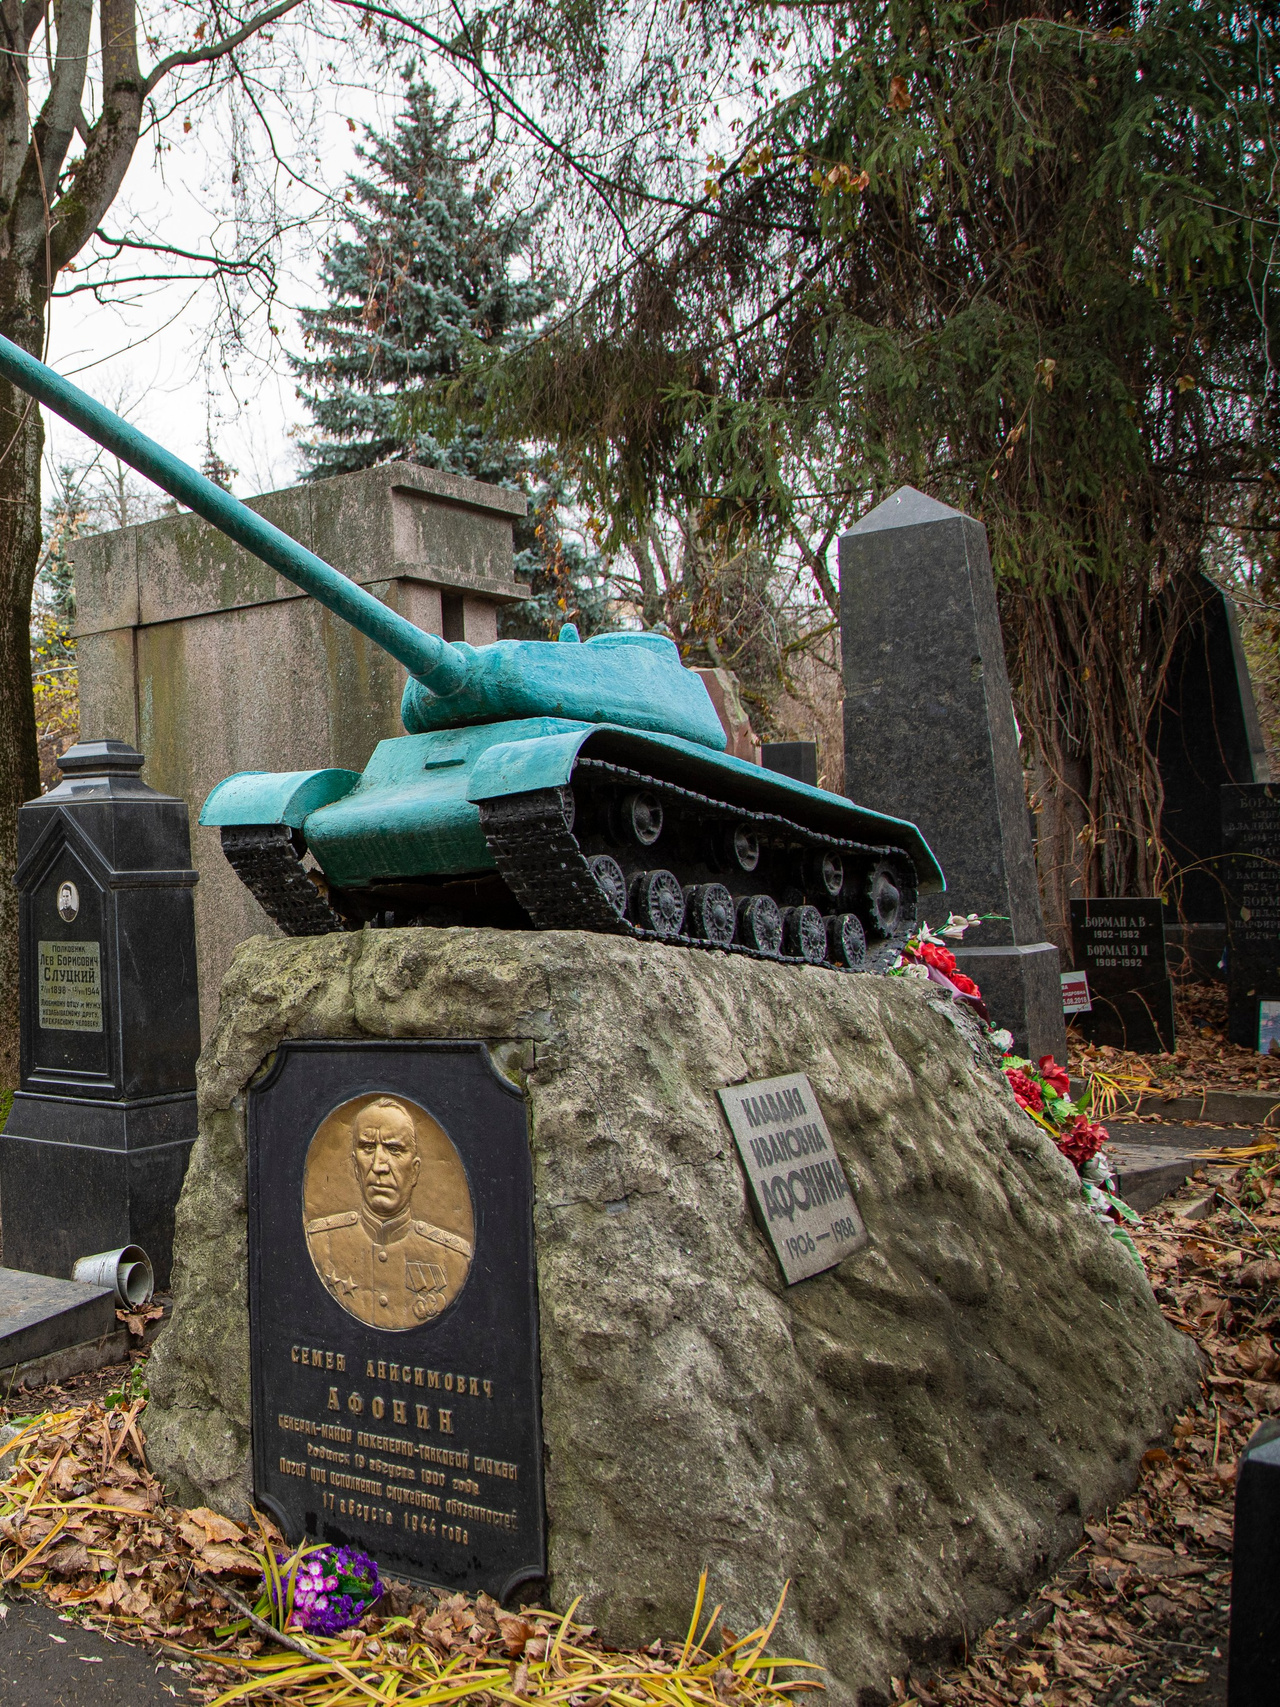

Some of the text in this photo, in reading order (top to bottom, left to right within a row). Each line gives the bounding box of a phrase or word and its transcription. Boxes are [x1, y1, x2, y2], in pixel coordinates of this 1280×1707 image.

[1085, 916, 1127, 927] БОРМАН
[1087, 945, 1129, 956] БОРМАН
[44, 967, 95, 984] СЛУЦКИЙ
[740, 1088, 807, 1127] КЛАВДИЯ
[749, 1123, 828, 1168] ИВАНОВНА
[761, 1158, 851, 1222] АФОНИНА
[291, 1345, 494, 1399] СЕМЕН АНИСИМОВИЧ
[327, 1386, 454, 1434] АФОНИН
[310, 1466, 326, 1484] при
[355, 1454, 365, 1468] 19
[421, 1468, 445, 1486] 1900
[474, 1456, 518, 1480] СЛУЖБЫ
[322, 1491, 335, 1510] 17
[403, 1512, 436, 1535] 1944
